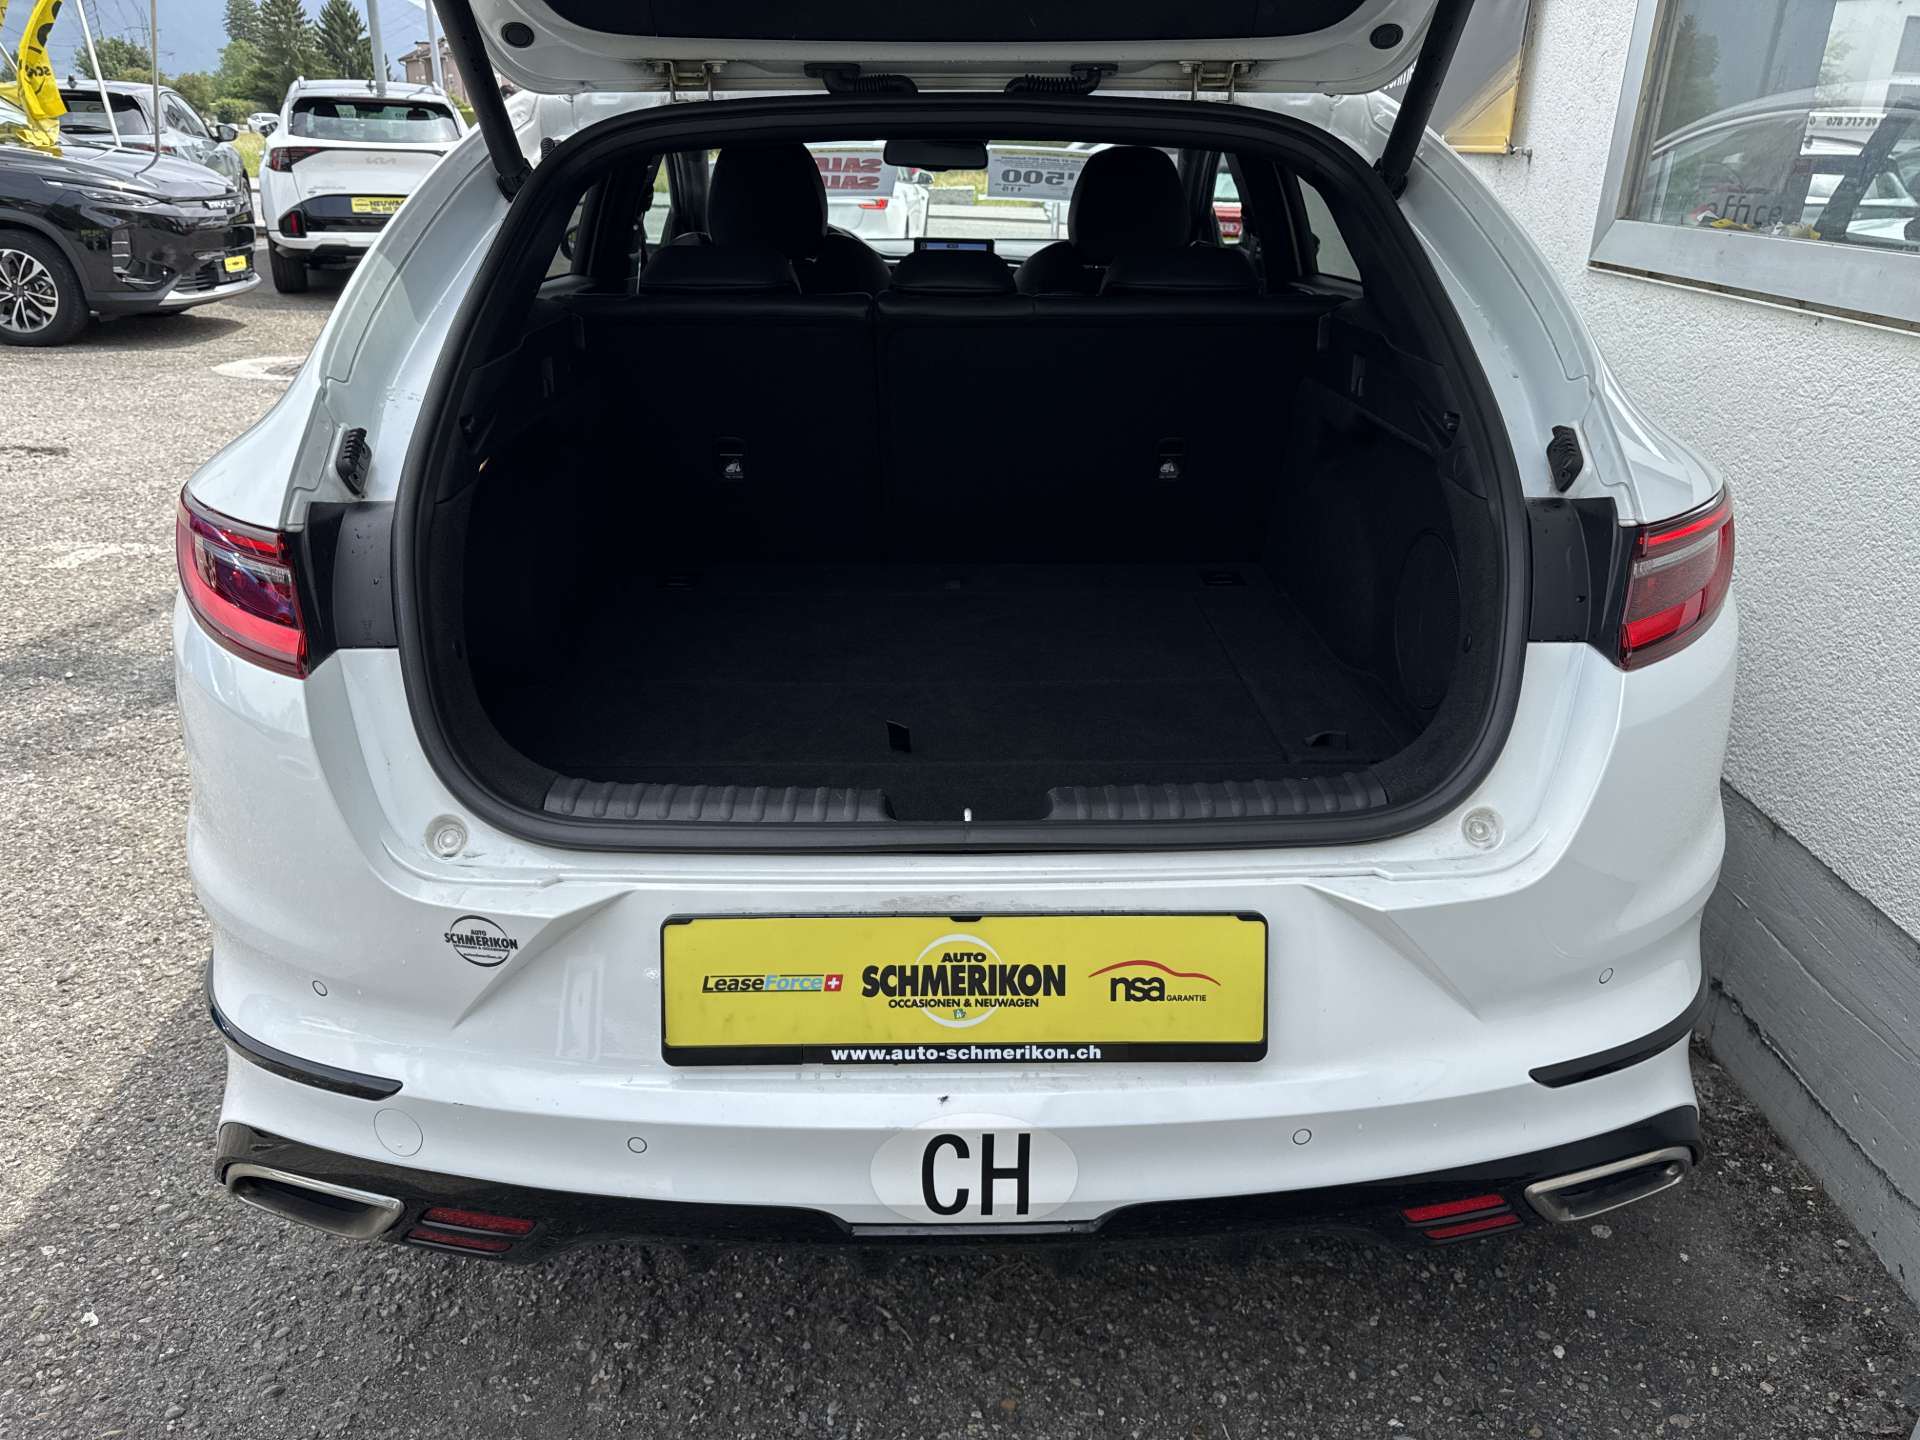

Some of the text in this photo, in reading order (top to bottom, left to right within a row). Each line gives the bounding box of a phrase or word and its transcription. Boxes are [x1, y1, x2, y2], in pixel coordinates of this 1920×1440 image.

[444, 932, 518, 950] SCHMERIKON
[941, 952, 987, 963] AUTO
[702, 974, 824, 993] LeaseForce
[861, 964, 1066, 998] SCHMERIKON
[1110, 977, 1207, 1002] nsa GARANTIE
[888, 998, 1039, 1009] OCCASIONEN & NEUWAGEN
[831, 1045, 1101, 1061] www.auto-schmerikon.ch
[921, 1132, 1031, 1216] CH
